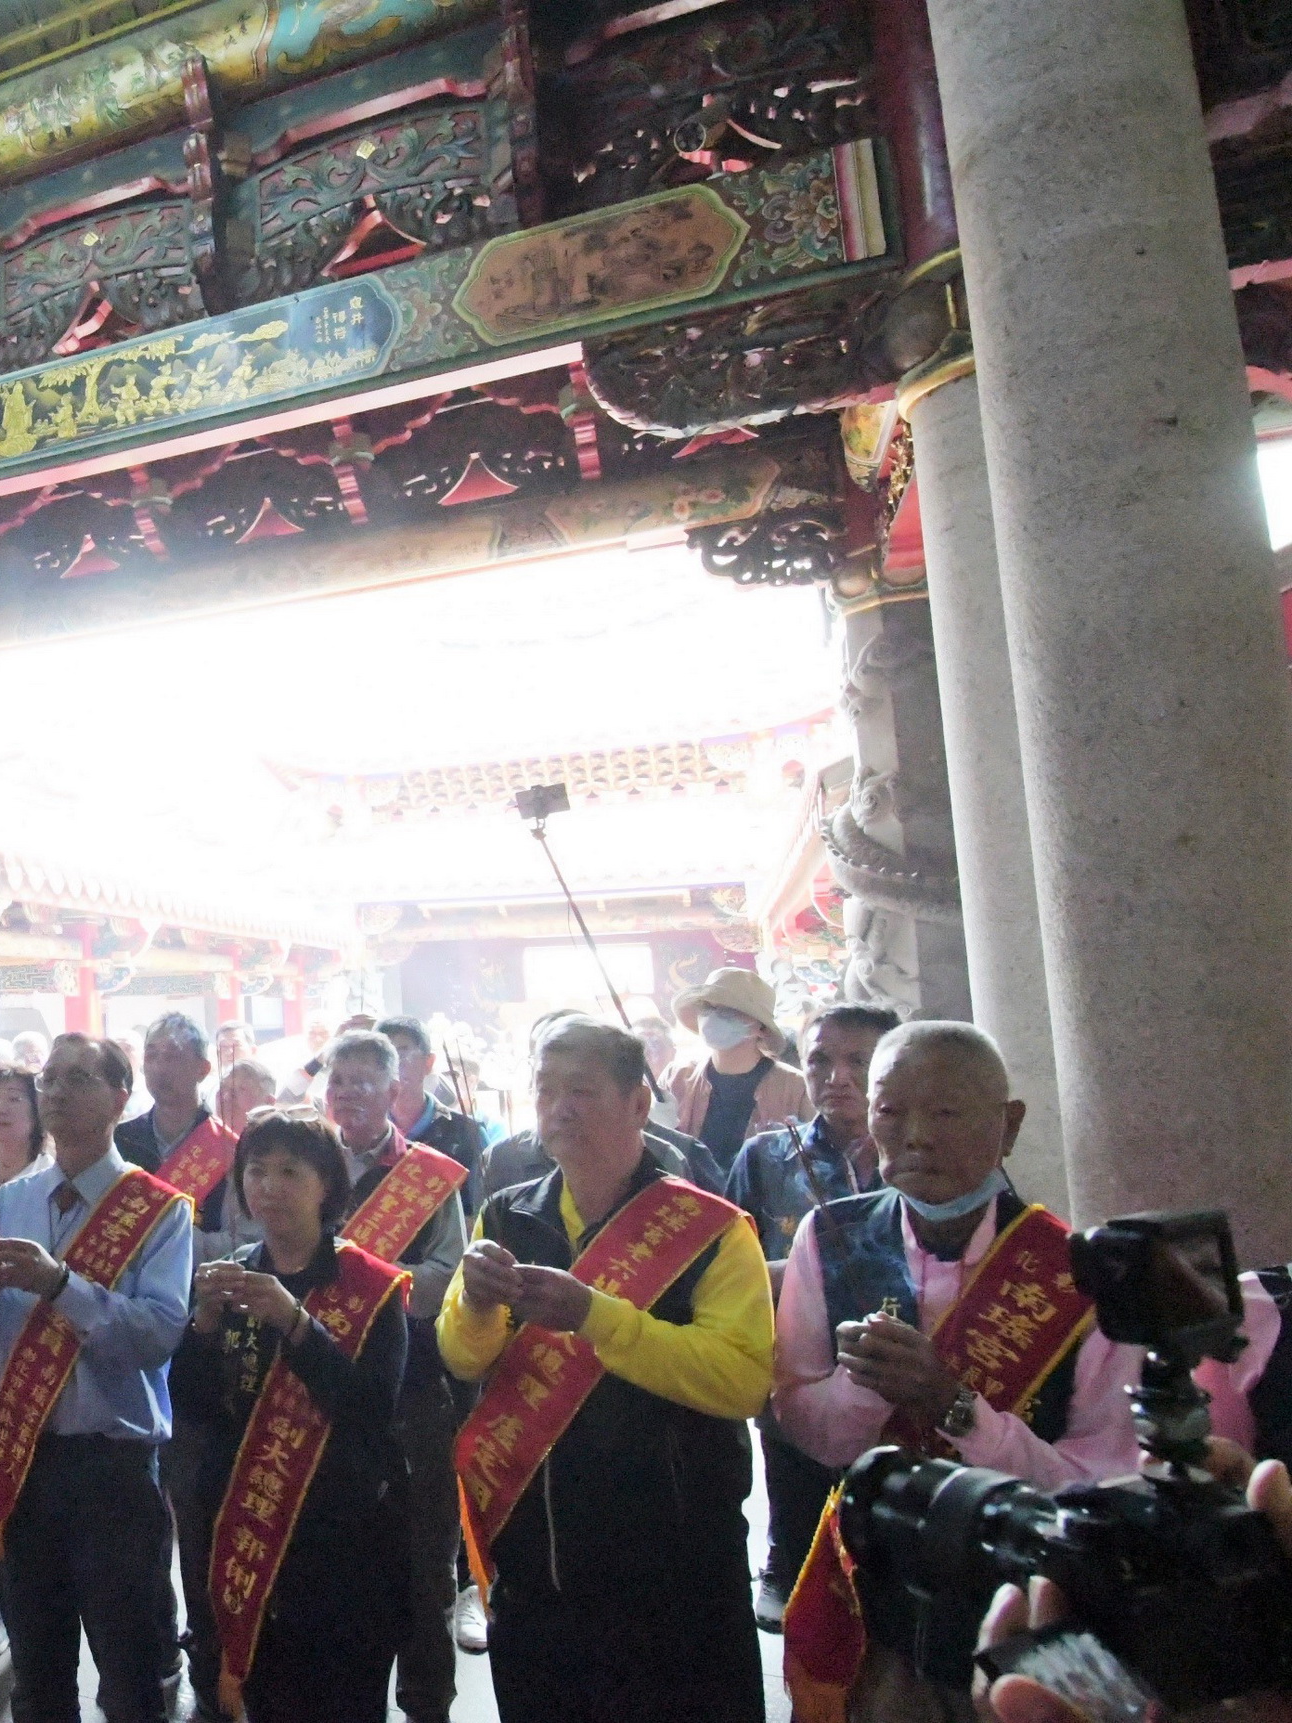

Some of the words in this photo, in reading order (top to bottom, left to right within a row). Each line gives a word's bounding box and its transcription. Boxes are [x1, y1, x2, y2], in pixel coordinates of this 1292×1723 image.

[966, 1280, 1058, 1370] 南瑤宮
[240, 1416, 307, 1529] 副大總理
